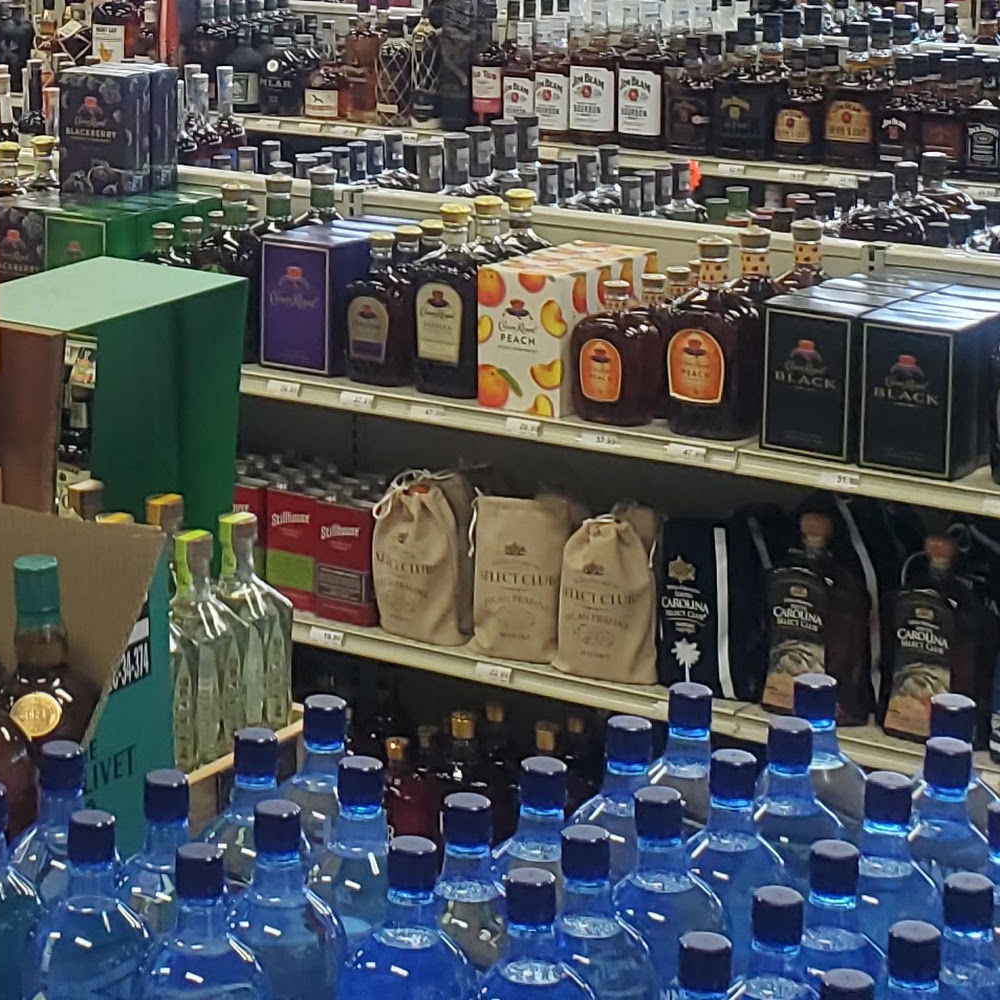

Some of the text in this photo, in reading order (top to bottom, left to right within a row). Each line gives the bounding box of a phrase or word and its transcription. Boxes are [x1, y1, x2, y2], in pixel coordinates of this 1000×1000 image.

[513, 82, 529, 95] BEAM
[545, 79, 563, 93] BEAM
[585, 73, 605, 90] BEAM
[631, 76, 651, 94] BEAM
[65, 126, 117, 140] BLACKBERRY
[500, 332, 536, 346] PEACH
[681, 367, 710, 379] PEACH
[775, 371, 837, 390] BLACK
[873, 386, 940, 406] BLACK
[272, 511, 311, 527] Stillhouse
[321, 524, 361, 540] Stillhouse
[661, 595, 710, 615] CAROLINA
[772, 606, 823, 625] CAROLINA
[896, 627, 948, 649] CAROLINA
[83, 744, 136, 795] LIVET
